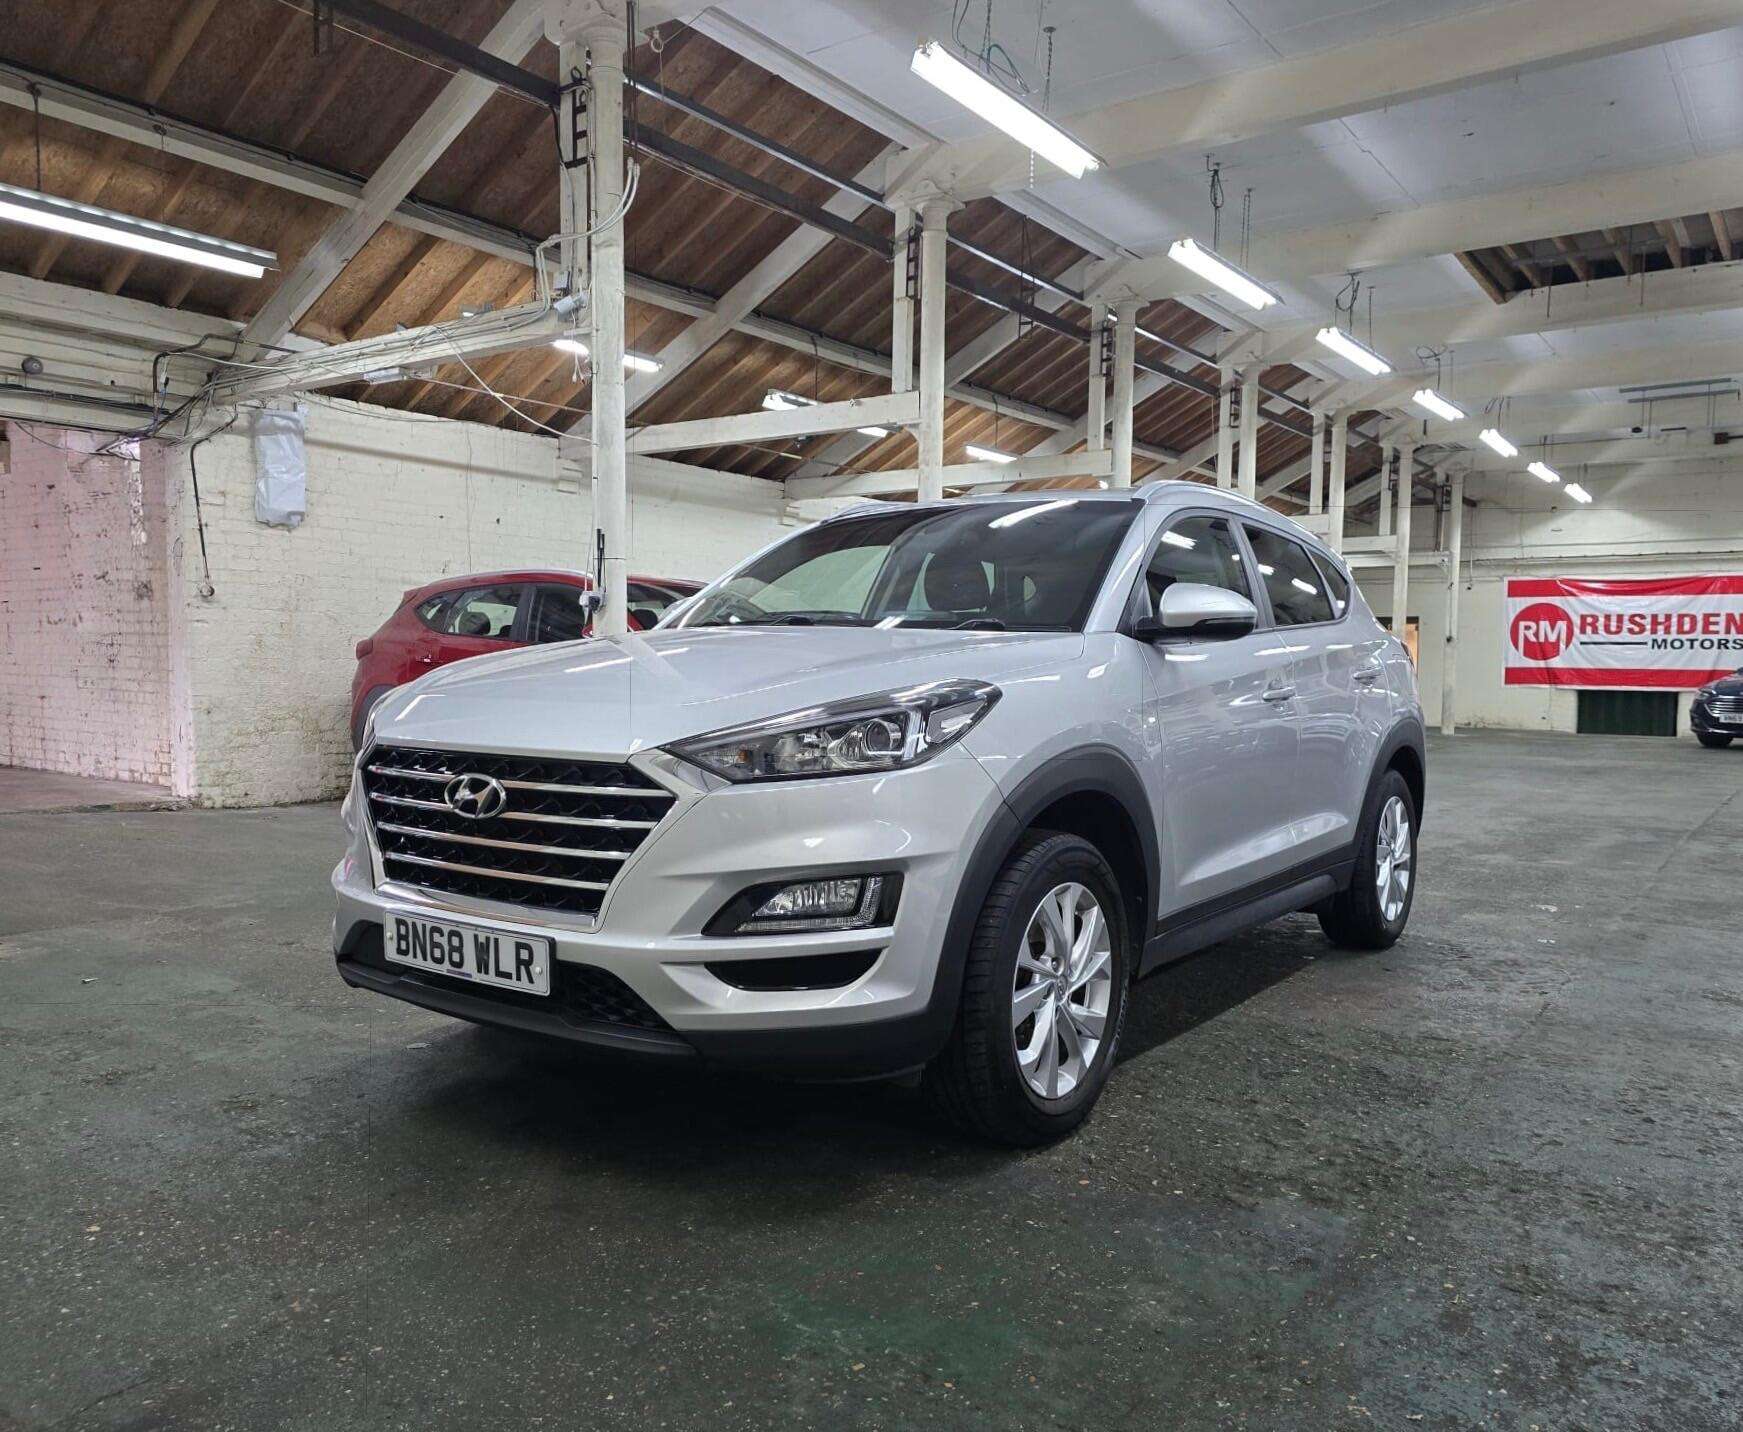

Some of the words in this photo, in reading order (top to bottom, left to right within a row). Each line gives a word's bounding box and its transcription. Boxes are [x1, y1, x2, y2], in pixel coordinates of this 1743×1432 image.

[1518, 620, 1567, 650] RM
[1579, 613, 1743, 635] RUSHDEN
[1651, 638, 1743, 650] MOTORS
[395, 917, 464, 968] BN68
[473, 933, 535, 984] WLR
